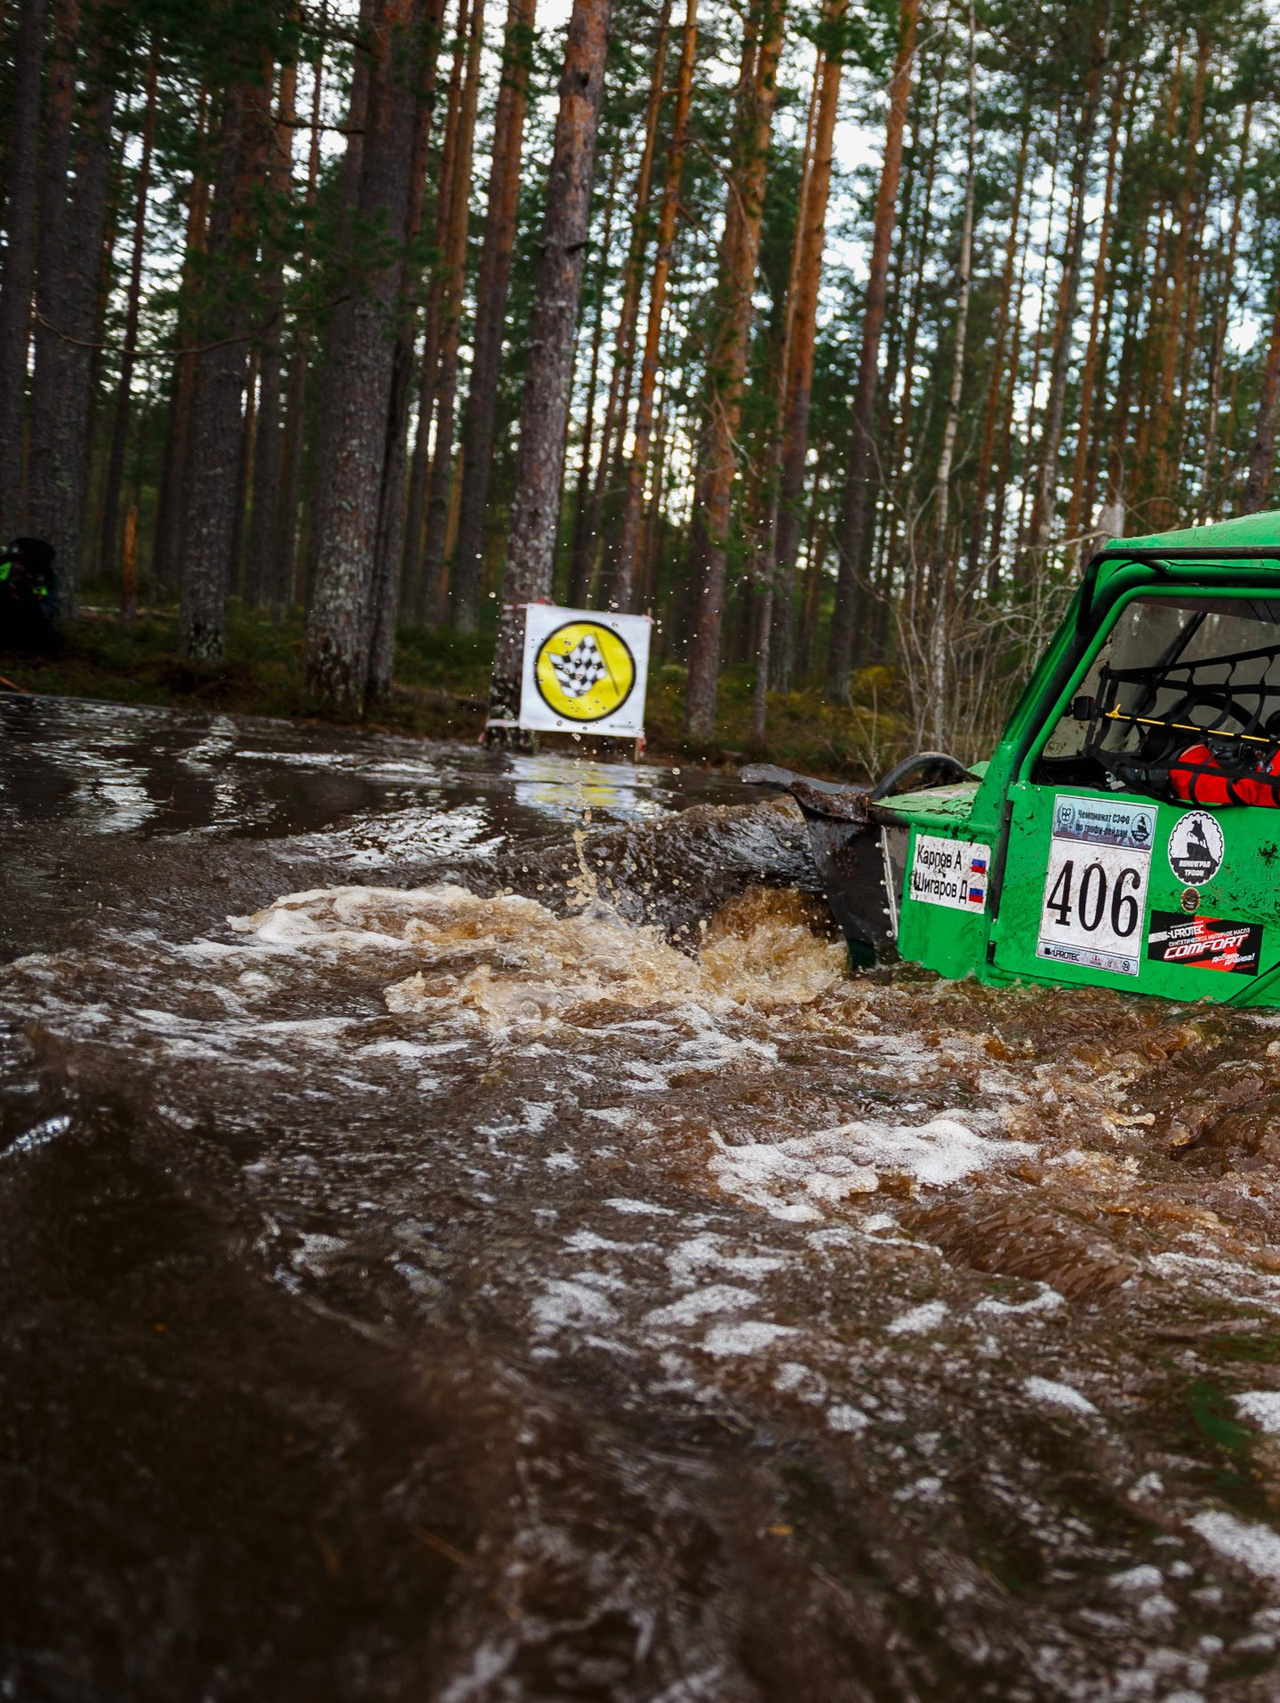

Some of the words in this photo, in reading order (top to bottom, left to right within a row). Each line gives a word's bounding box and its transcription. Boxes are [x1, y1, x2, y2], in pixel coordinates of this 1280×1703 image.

[1078, 809, 1112, 822] Чемпионат
[1112, 813, 1130, 825] СЗФО
[916, 844, 952, 869] Карпов
[953, 850, 962, 871] А
[913, 871, 957, 900] Шигаров
[959, 879, 968, 904] Д
[1046, 859, 1141, 938] 406
[1163, 933, 1249, 960] COMFORT
